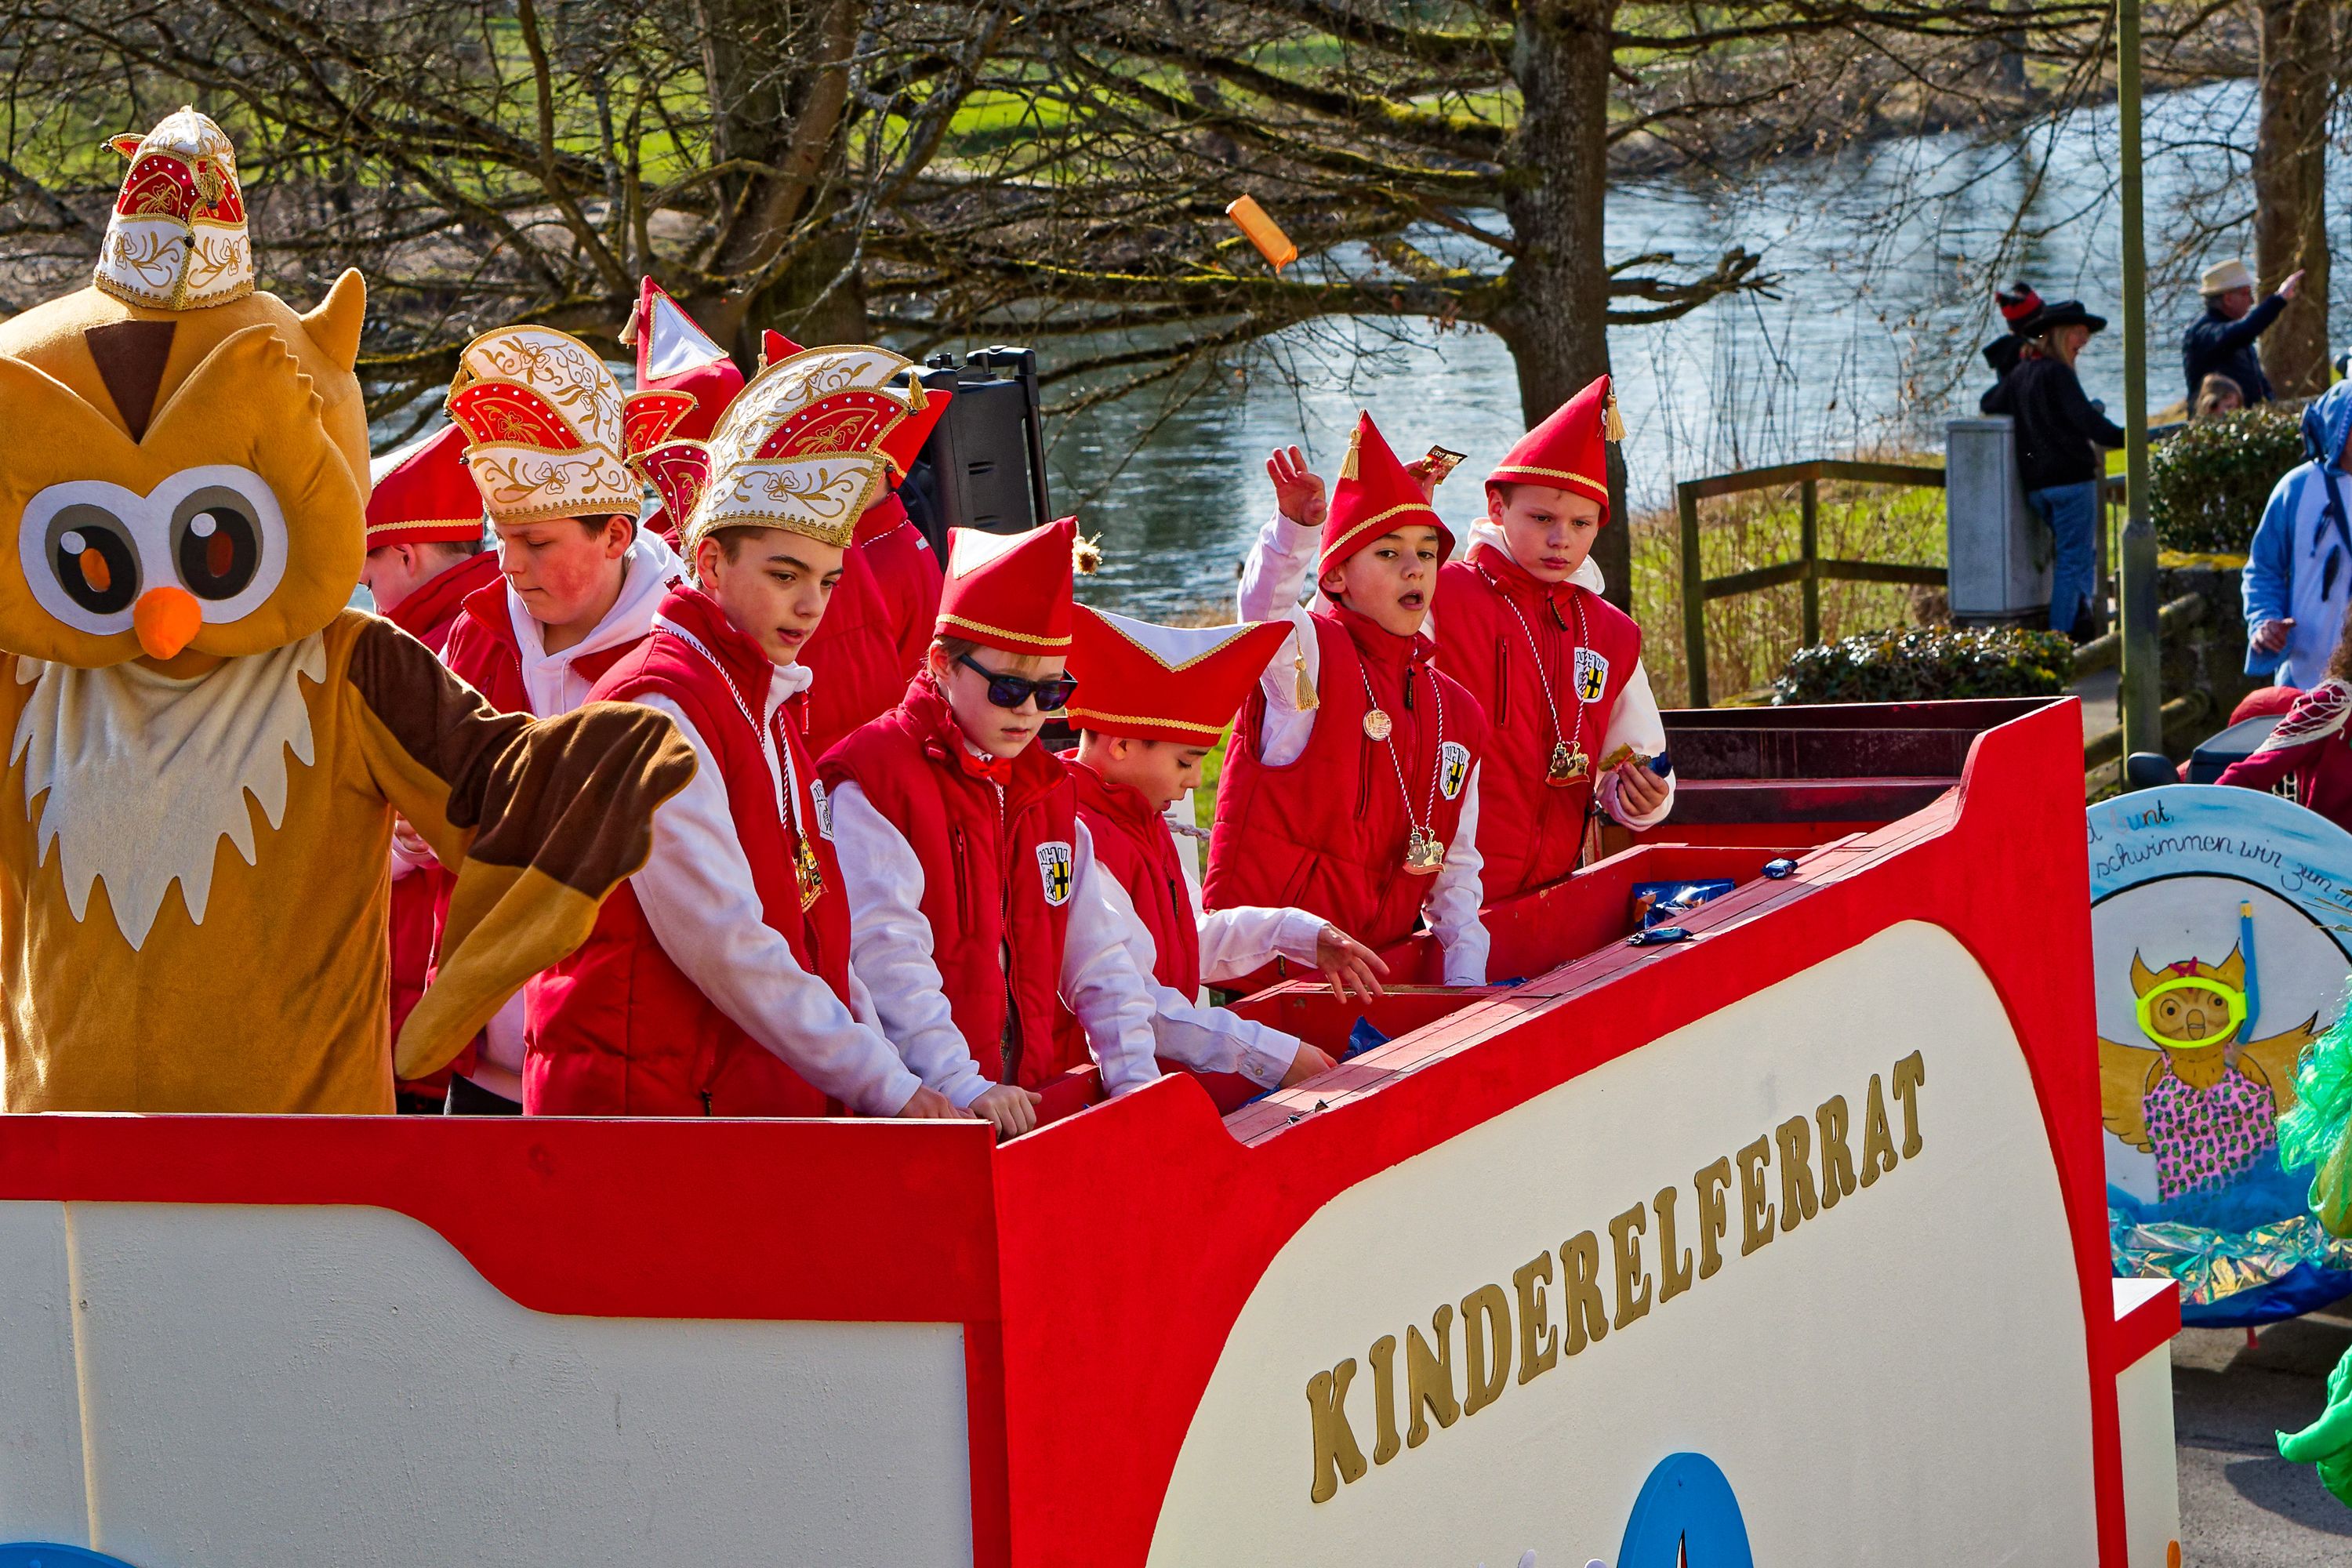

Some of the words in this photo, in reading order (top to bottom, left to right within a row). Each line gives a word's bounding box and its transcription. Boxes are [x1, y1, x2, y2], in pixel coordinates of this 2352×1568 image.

[1576, 651, 1606, 671] UHU
[1038, 847, 1068, 864] UHU
[2096, 834, 2234, 879] schwimmen
[2239, 839, 2282, 869] wir
[2281, 862, 2332, 892] zum
[1305, 1049, 1926, 1504] KINDERELFERRAT
